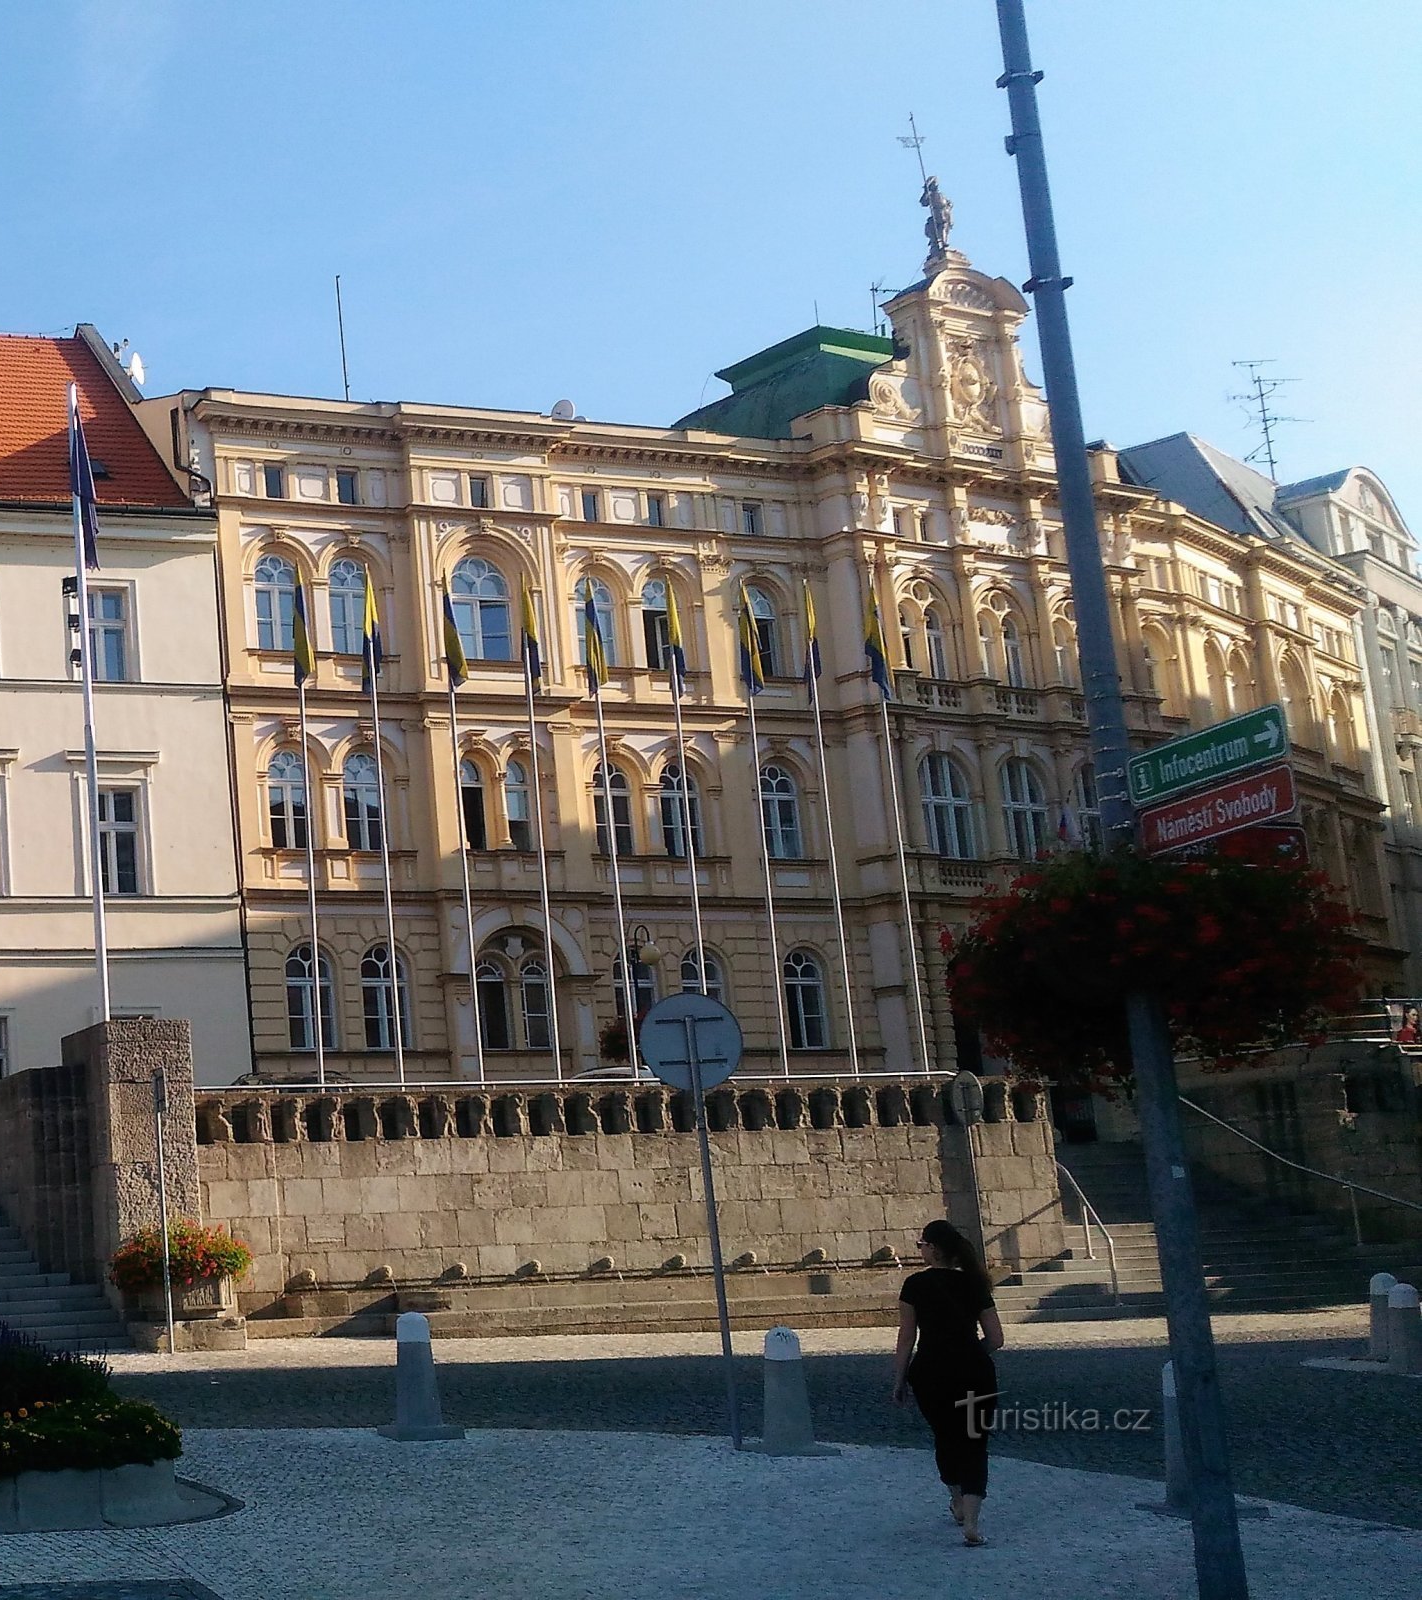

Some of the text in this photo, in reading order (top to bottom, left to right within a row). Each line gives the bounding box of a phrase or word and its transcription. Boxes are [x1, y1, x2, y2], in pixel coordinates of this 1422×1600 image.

[1158, 737, 1249, 784] Infocentrum
[1157, 783, 1277, 843] Náměstí Svobody
